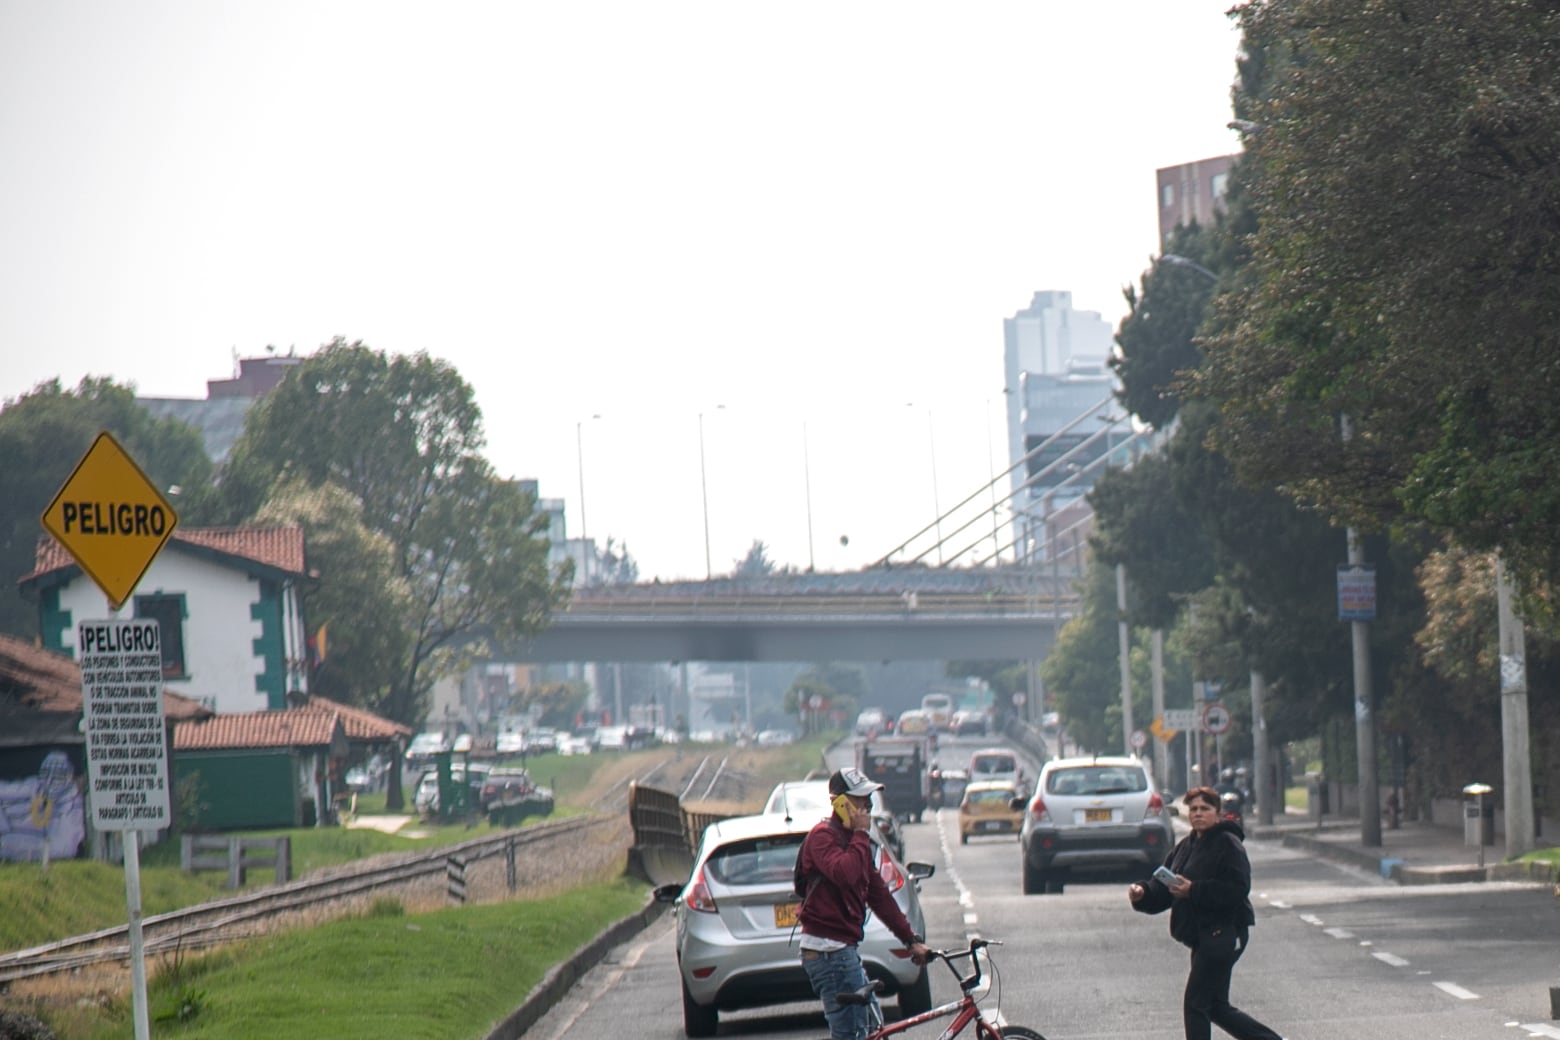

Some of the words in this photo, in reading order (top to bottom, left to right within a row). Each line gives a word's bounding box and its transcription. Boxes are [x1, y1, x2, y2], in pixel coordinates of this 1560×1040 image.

[62, 502, 166, 537] PELIGRO
[80, 625, 159, 653] ¡PELIGRO!
[124, 654, 159, 667] CONDUCTORES
